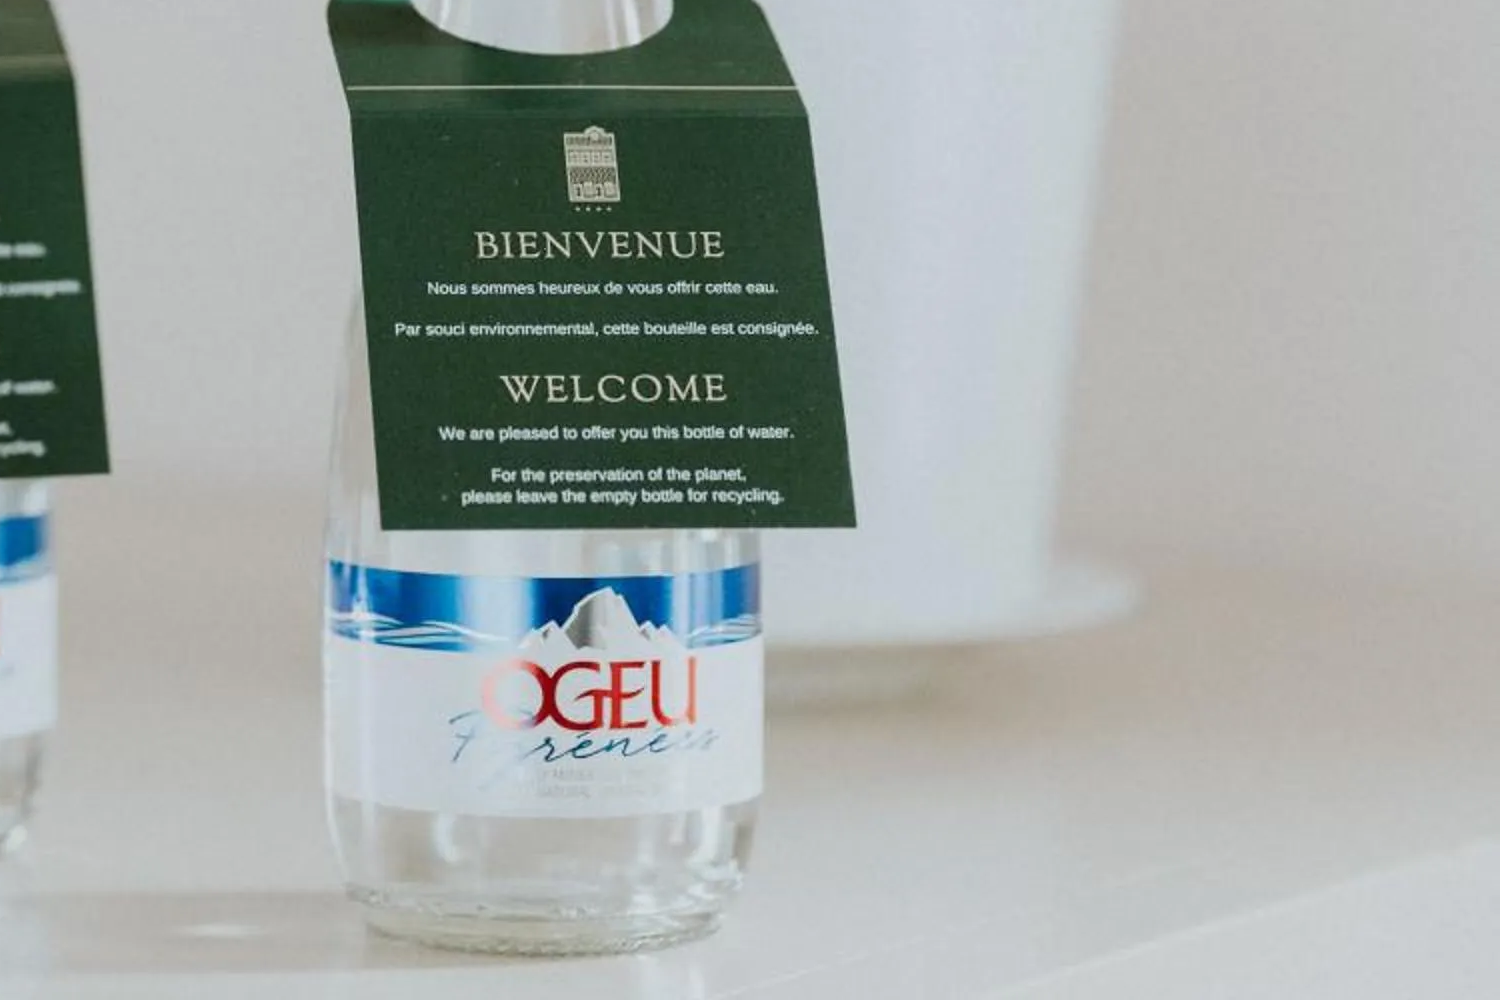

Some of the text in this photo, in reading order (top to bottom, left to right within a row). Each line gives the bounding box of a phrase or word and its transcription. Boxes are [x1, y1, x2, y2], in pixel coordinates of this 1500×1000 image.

[474, 231, 725, 259] BIENVENUE
[427, 280, 779, 295] Nous sommes heureux de vous offrir cette eau.
[394, 321, 819, 339] Par souci environnemental, cette bouteille est consignée.
[499, 374, 727, 403] WELCOME
[438, 424, 795, 443] We are pleased to offer you this bottle of water.
[491, 467, 517, 483] For
[520, 467, 546, 483] the
[549, 467, 645, 485] preservation
[647, 466, 663, 482] of
[665, 467, 692, 482] the
[461, 487, 785, 507] please leave the empty bottle for recycling.
[482, 655, 697, 731] OGEU
[449, 708, 720, 780] Prénés
